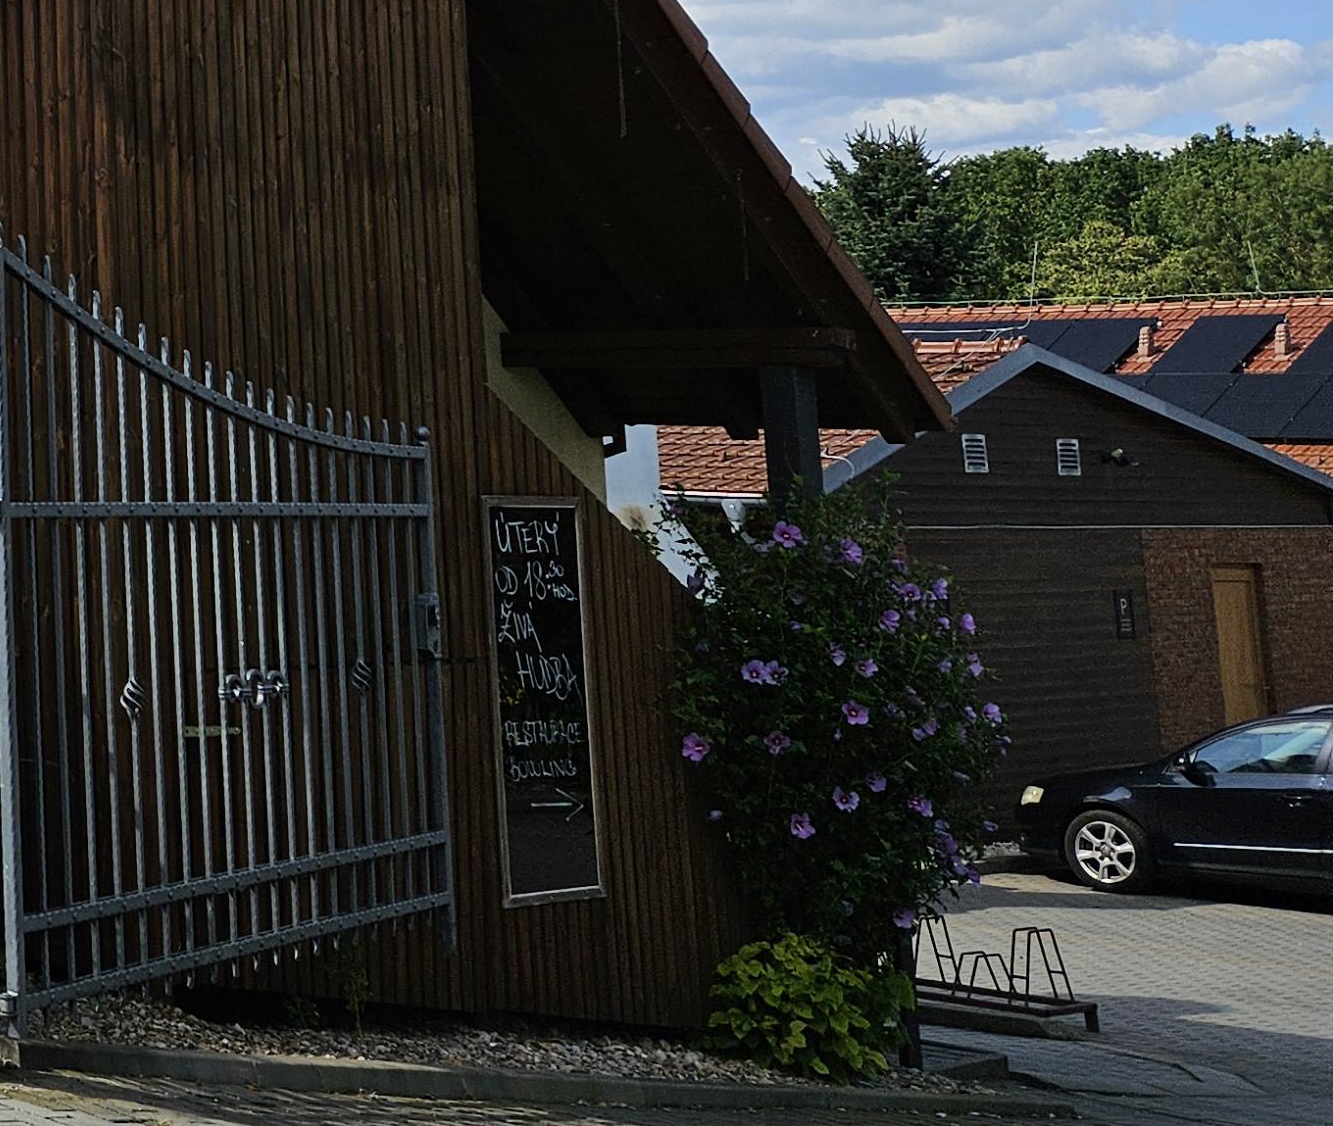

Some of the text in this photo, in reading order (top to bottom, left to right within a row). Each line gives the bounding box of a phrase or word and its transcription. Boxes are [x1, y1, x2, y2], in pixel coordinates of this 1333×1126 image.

[495, 511, 560, 556] ÚTERÝ
[495, 565, 518, 595] OD
[515, 650, 582, 708] HUDBA
[501, 719, 585, 747] RESTAURACE
[507, 757, 577, 782] BOWLING
